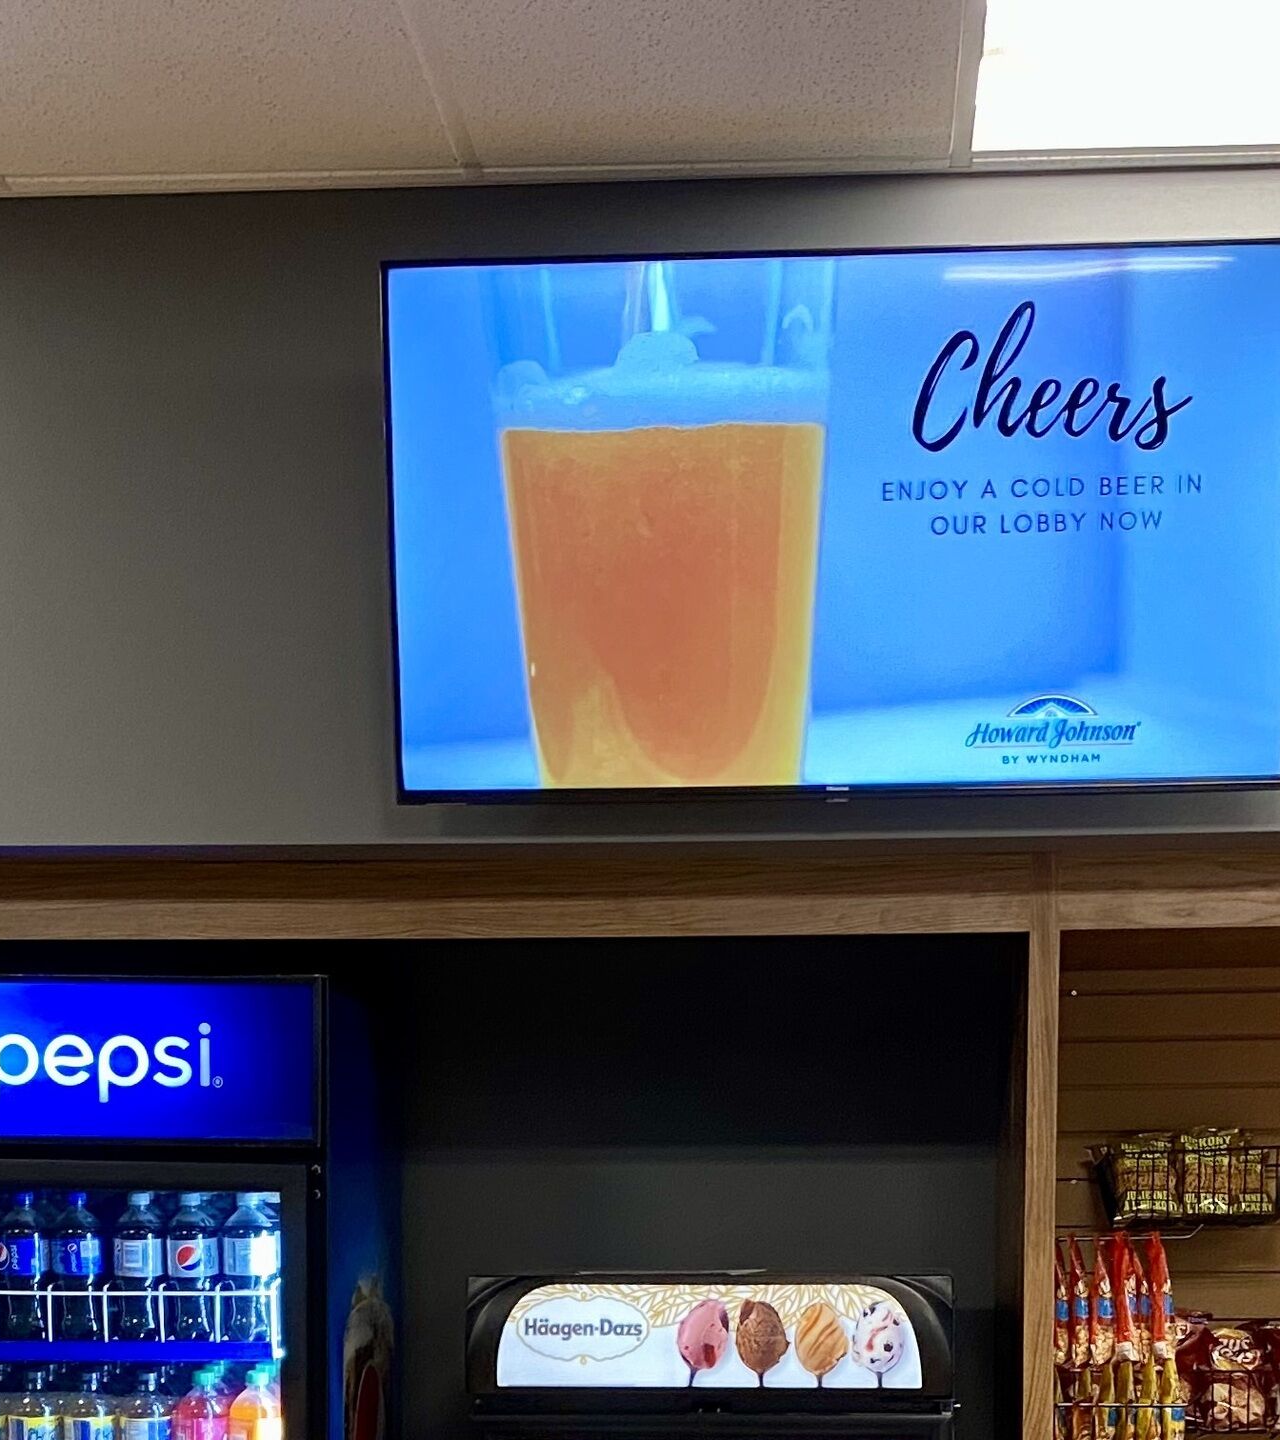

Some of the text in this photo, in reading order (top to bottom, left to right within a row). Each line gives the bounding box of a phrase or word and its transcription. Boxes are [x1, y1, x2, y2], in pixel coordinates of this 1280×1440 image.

[911, 300, 1194, 452] Cheers
[881, 473, 1202, 502] ENJOY A COLD BEER IN
[930, 510, 1163, 536] OUR LOBBY NOW
[965, 718, 1137, 749] Howard Johnson
[1001, 753, 1101, 765] BY WYNDHAM
[523, 1318, 643, 1342] Häagen-Dazs
